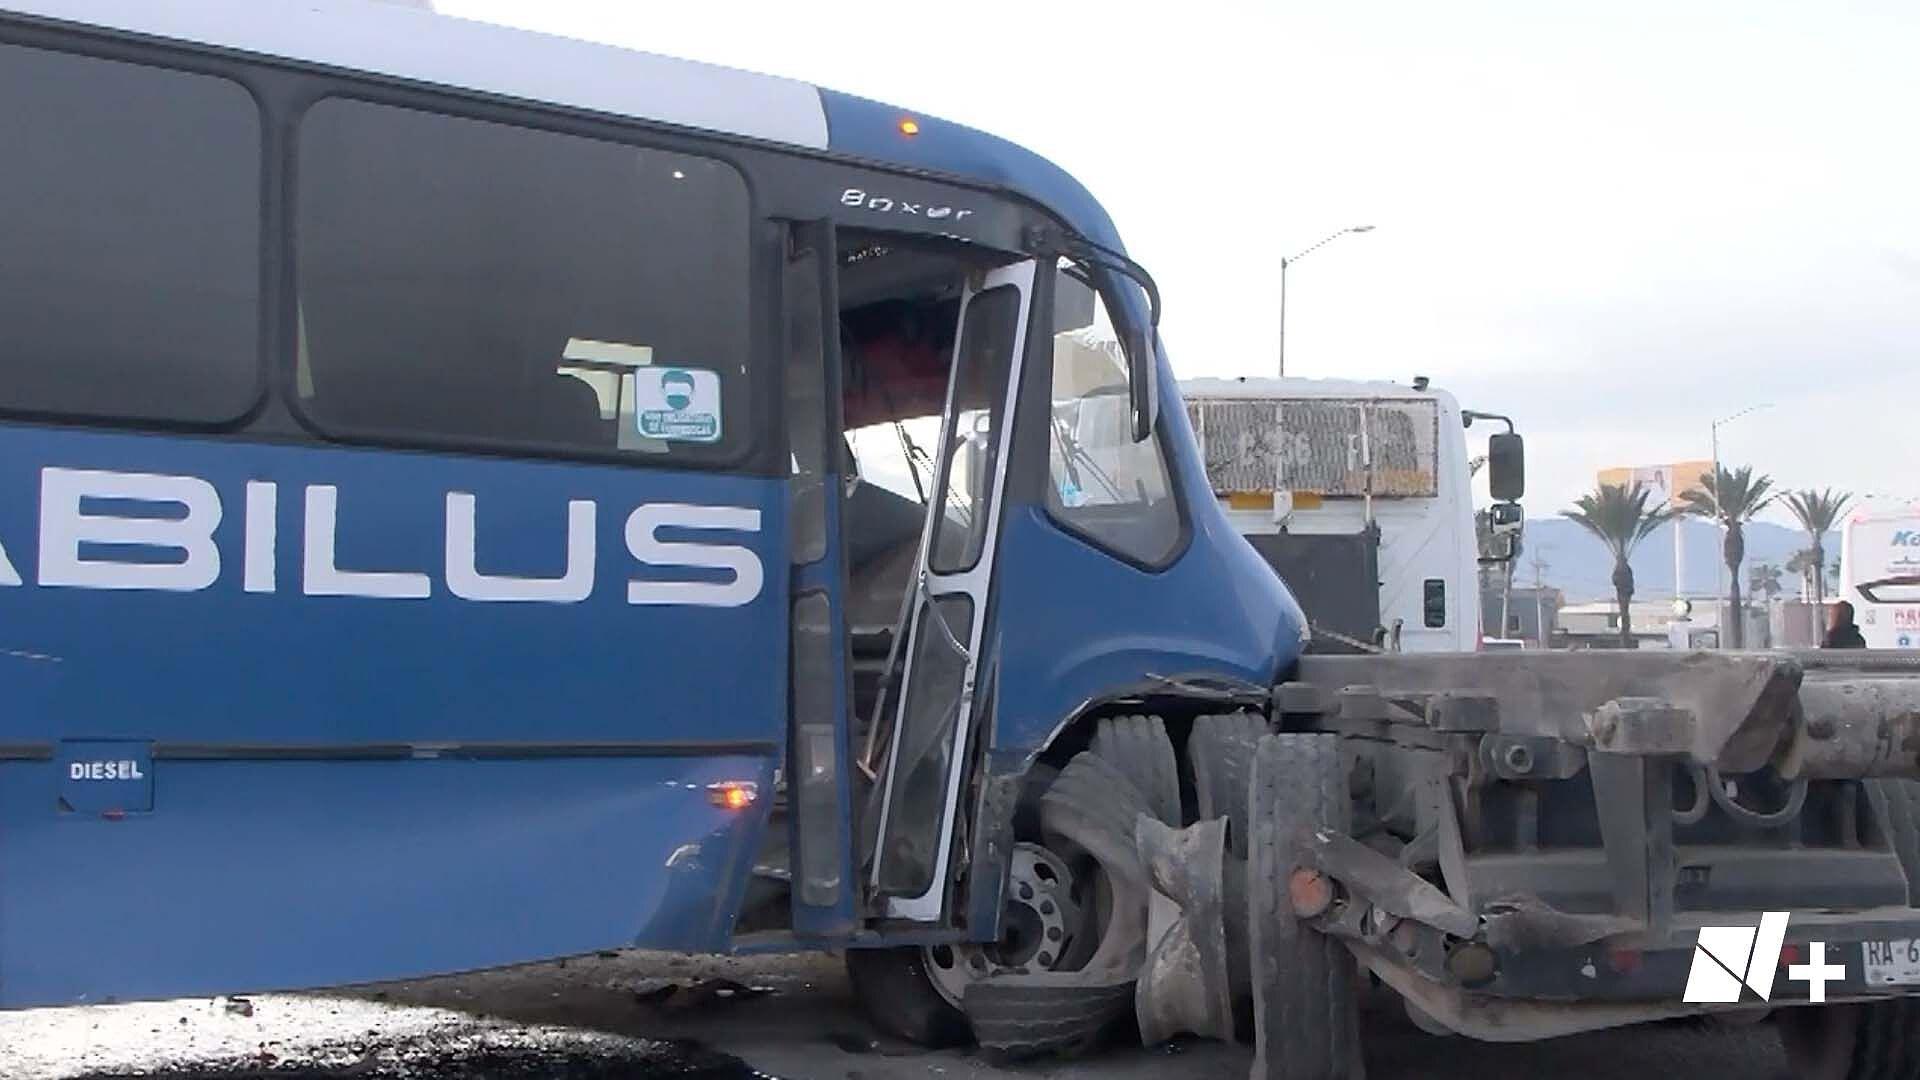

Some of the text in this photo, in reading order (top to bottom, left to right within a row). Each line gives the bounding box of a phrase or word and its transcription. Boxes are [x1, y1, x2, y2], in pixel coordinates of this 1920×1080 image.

[840, 188, 973, 220] Boxer
[0, 467, 764, 608] BILUS
[70, 760, 144, 780] DIESEL
